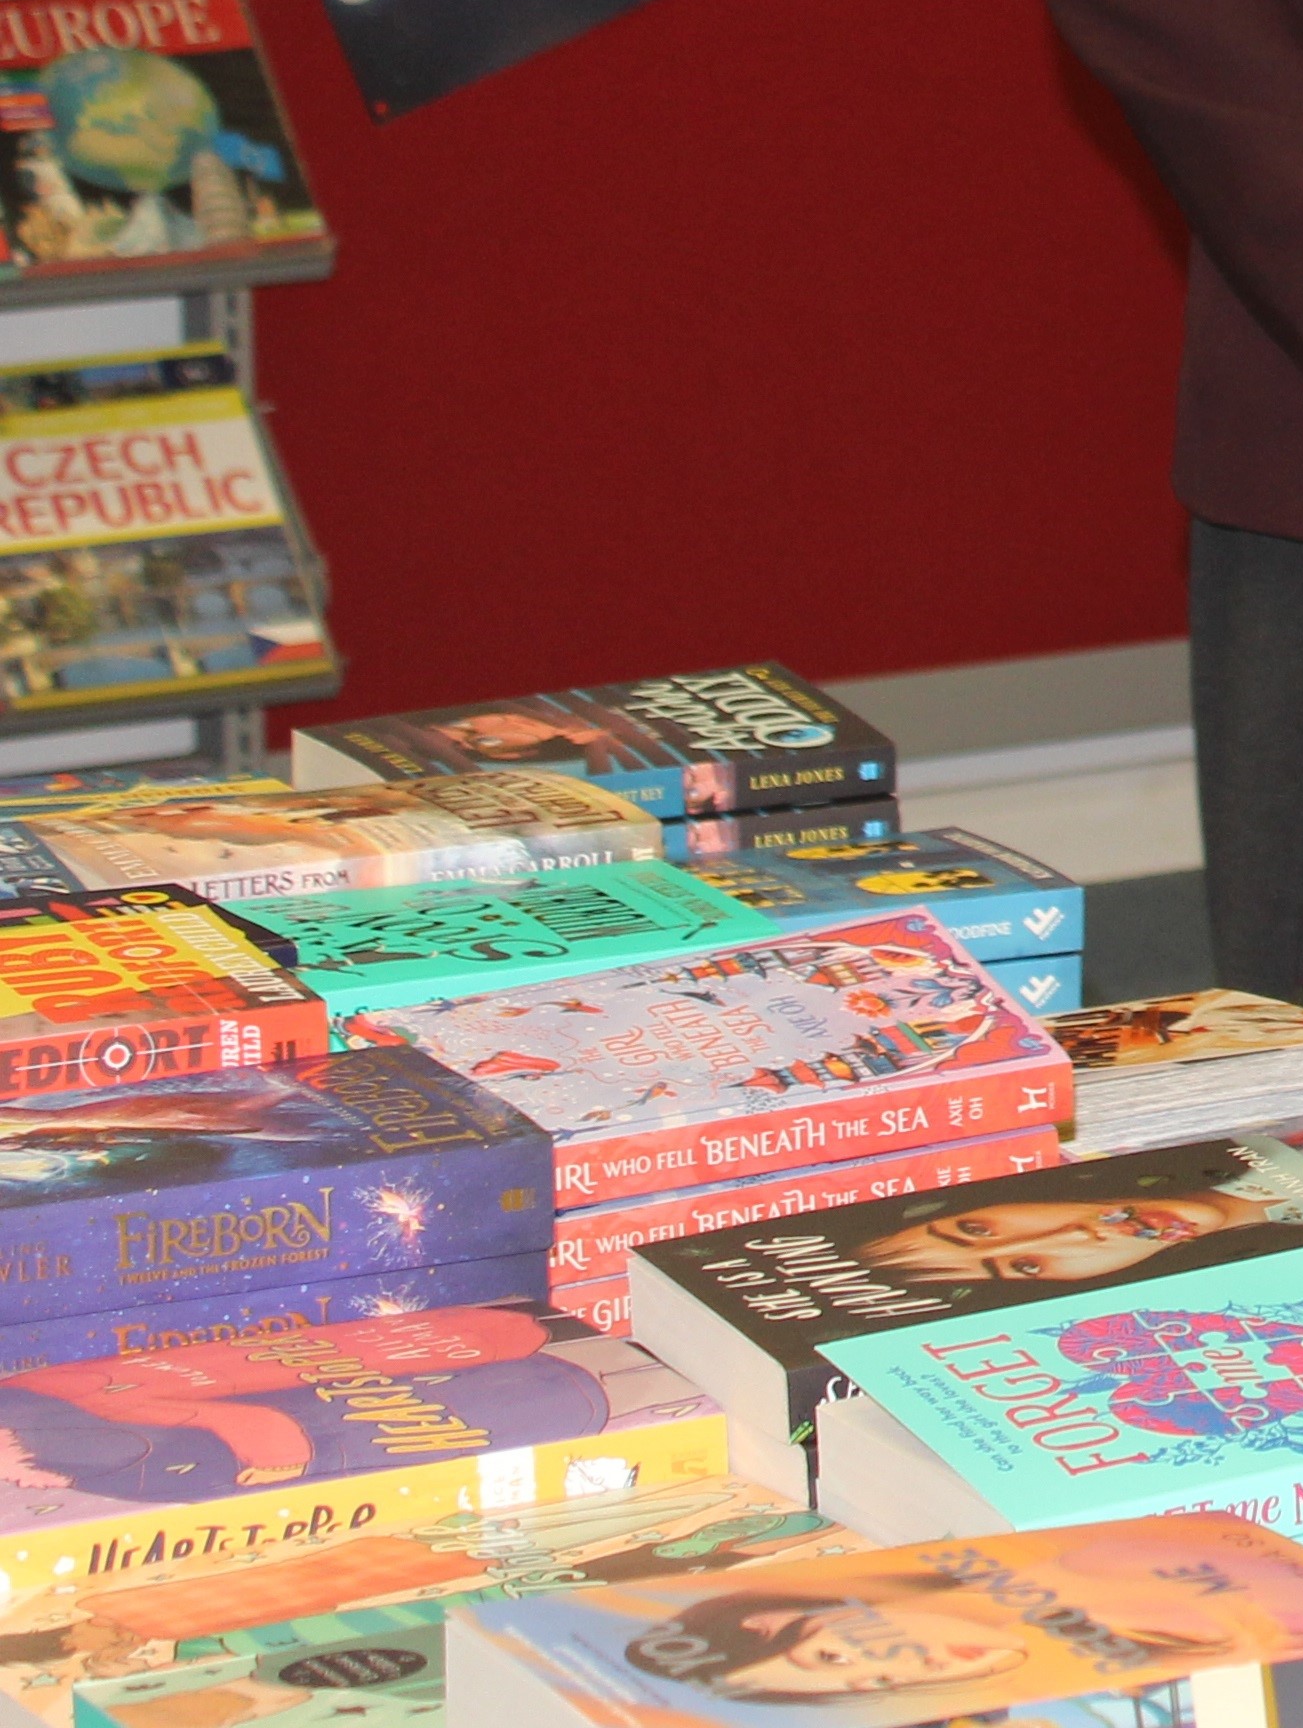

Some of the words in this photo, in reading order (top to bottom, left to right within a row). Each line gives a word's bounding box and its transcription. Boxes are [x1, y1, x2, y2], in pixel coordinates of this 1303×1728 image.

[5, 431, 206, 488] CZECH
[668, 669, 838, 747] ODDLY
[749, 772, 795, 791] LENA
[797, 766, 844, 787] JONES
[754, 831, 796, 849] LENA
[797, 823, 849, 846] JONES
[302, 868, 351, 888] FROM
[153, 911, 237, 952] CHILD
[946, 922, 1012, 942] OODFINE
[69, 917, 249, 1014] REDFORT
[202, 950, 306, 1003] LAUREN
[647, 1000, 742, 1070] BENEATH
[712, 1001, 775, 1038] SEA
[786, 1012, 837, 1040] AXIE
[0, 1024, 210, 1092] EDFORT
[604, 1024, 662, 1069] GIRL
[948, 1095, 964, 1128] AXIE
[969, 1096, 984, 1121] OH
[555, 1163, 598, 1194] IRL
[602, 1155, 651, 1180] WHO
[657, 1148, 697, 1173] FELL
[701, 1118, 825, 1166] BENEATH
[832, 1118, 869, 1139] THE
[878, 1106, 929, 1137] SEA
[1227, 1145, 1280, 1175] TRAN
[112, 1186, 335, 1270] FIREBORN
[595, 1230, 643, 1253] WHO
[225, 1255, 277, 1272] FROZEN
[282, 1247, 330, 1264] FOREST
[735, 1230, 953, 1320] HAUNTING
[742, 1286, 826, 1321] SHE
[1200, 1345, 1262, 1386] me
[227, 1331, 497, 1457] HEARTSTOPPER
[919, 1326, 1153, 1479] FORGET
